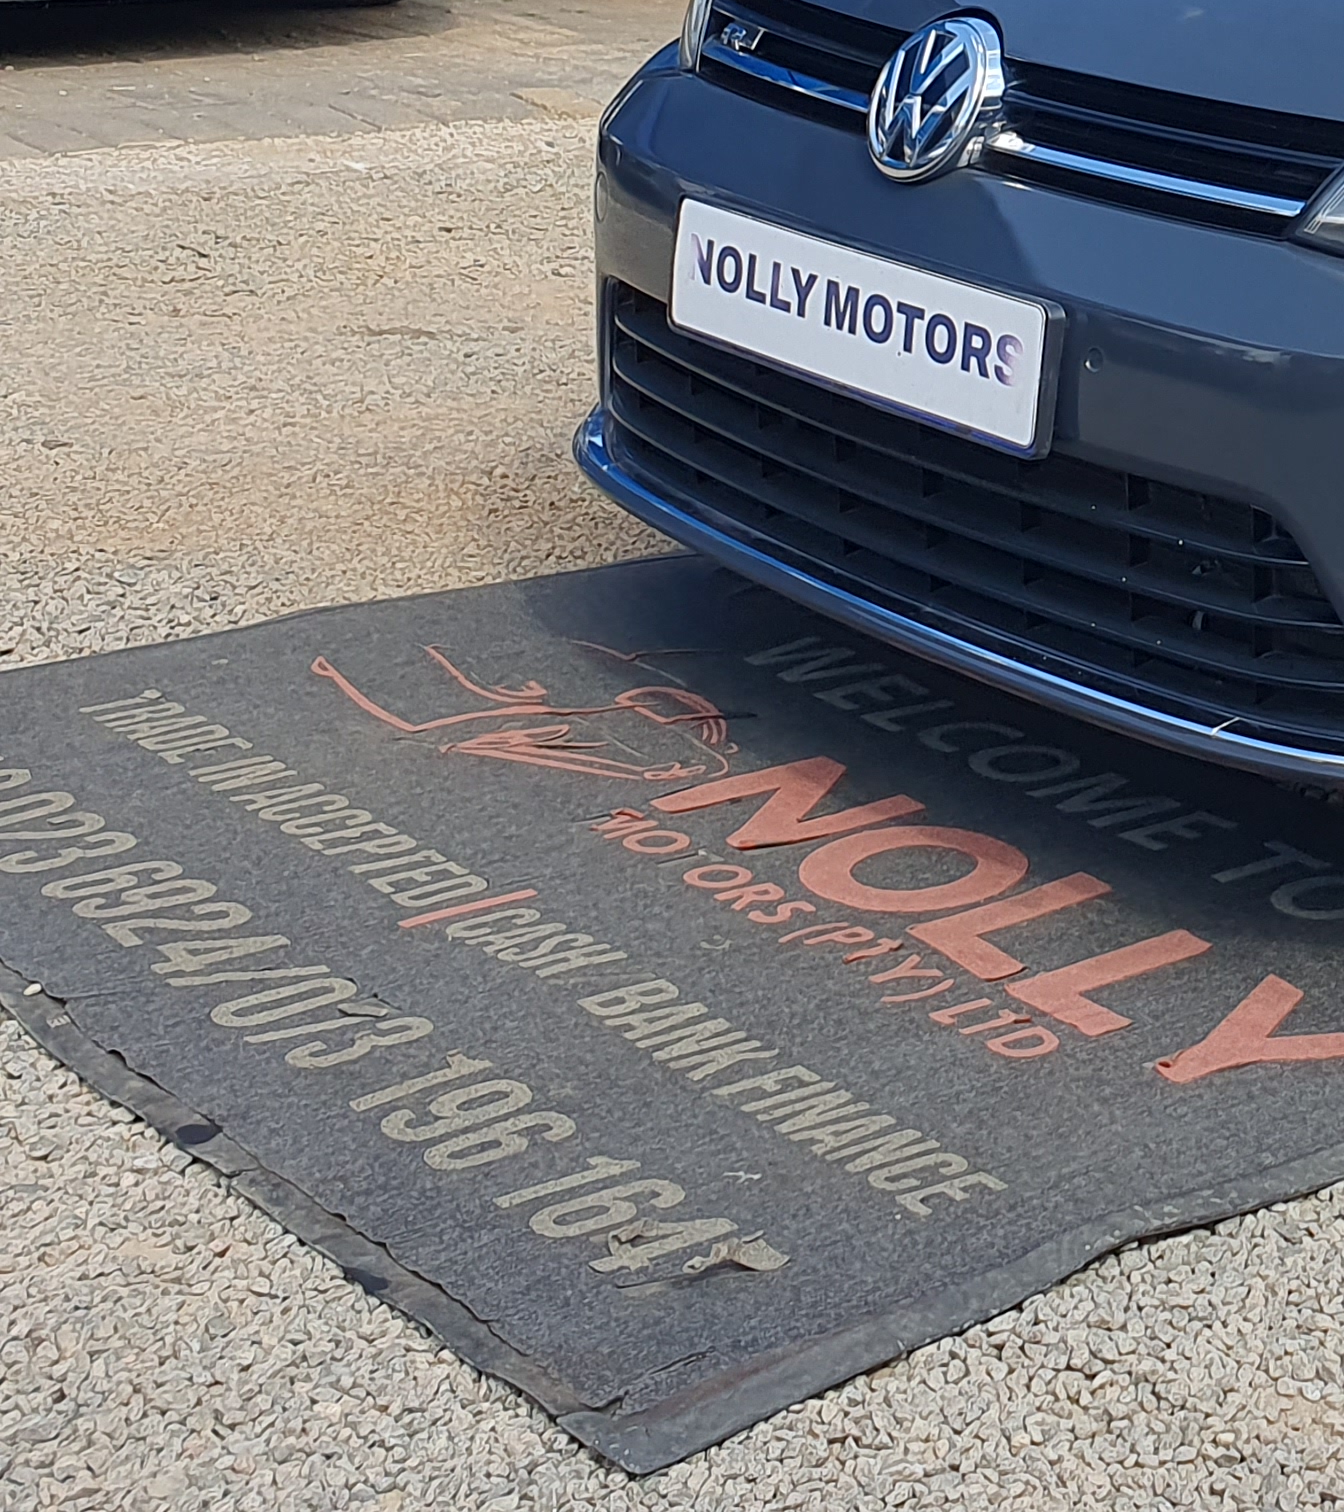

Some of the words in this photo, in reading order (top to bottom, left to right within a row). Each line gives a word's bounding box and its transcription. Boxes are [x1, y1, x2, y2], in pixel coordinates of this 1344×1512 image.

[690, 233, 818, 319] NOLLY
[823, 278, 1024, 387] MOTORS
[745, 636, 1238, 851] WELCOME
[79, 689, 254, 764] TRADE
[577, 978, 780, 1081] BANK
[709, 1064, 1009, 1218] FINANCE
[928, 998, 1060, 1059] LTD
[349, 1049, 577, 1172] 196
